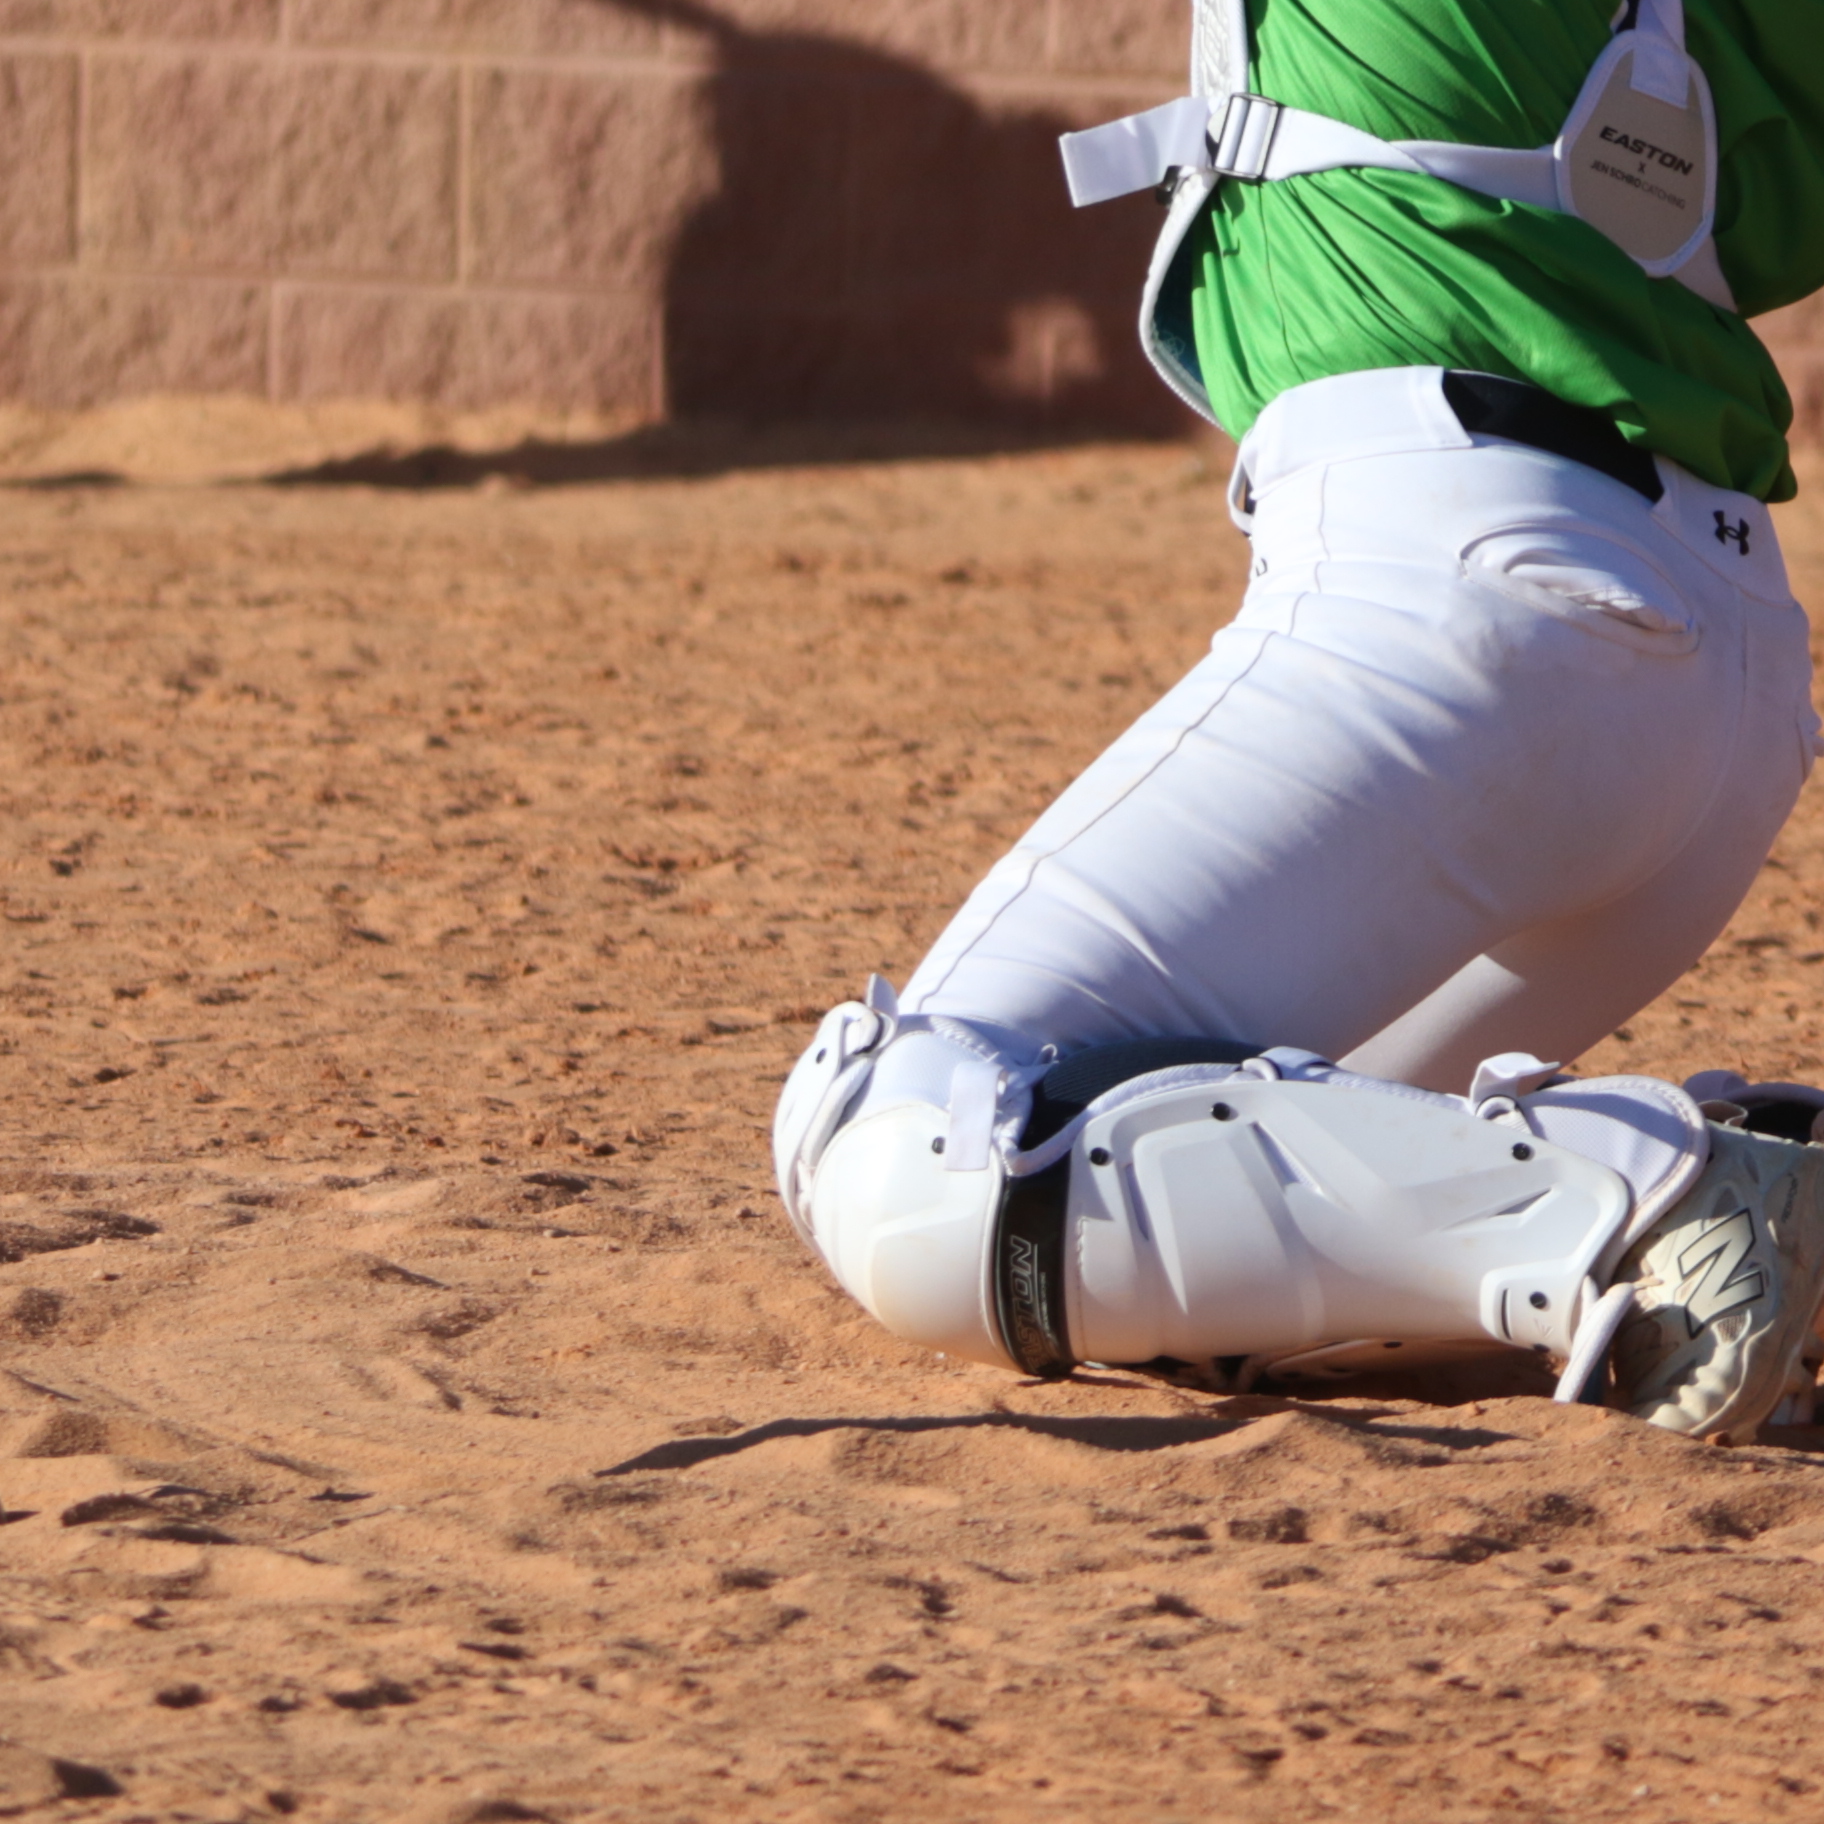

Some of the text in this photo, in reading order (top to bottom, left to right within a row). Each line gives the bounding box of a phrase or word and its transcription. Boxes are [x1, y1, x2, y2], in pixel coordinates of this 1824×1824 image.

[1599, 125, 1694, 176] EASTON
[1637, 162, 1647, 175] X
[1590, 159, 1610, 175] JEN
[1642, 180, 1687, 210] CATCHING
